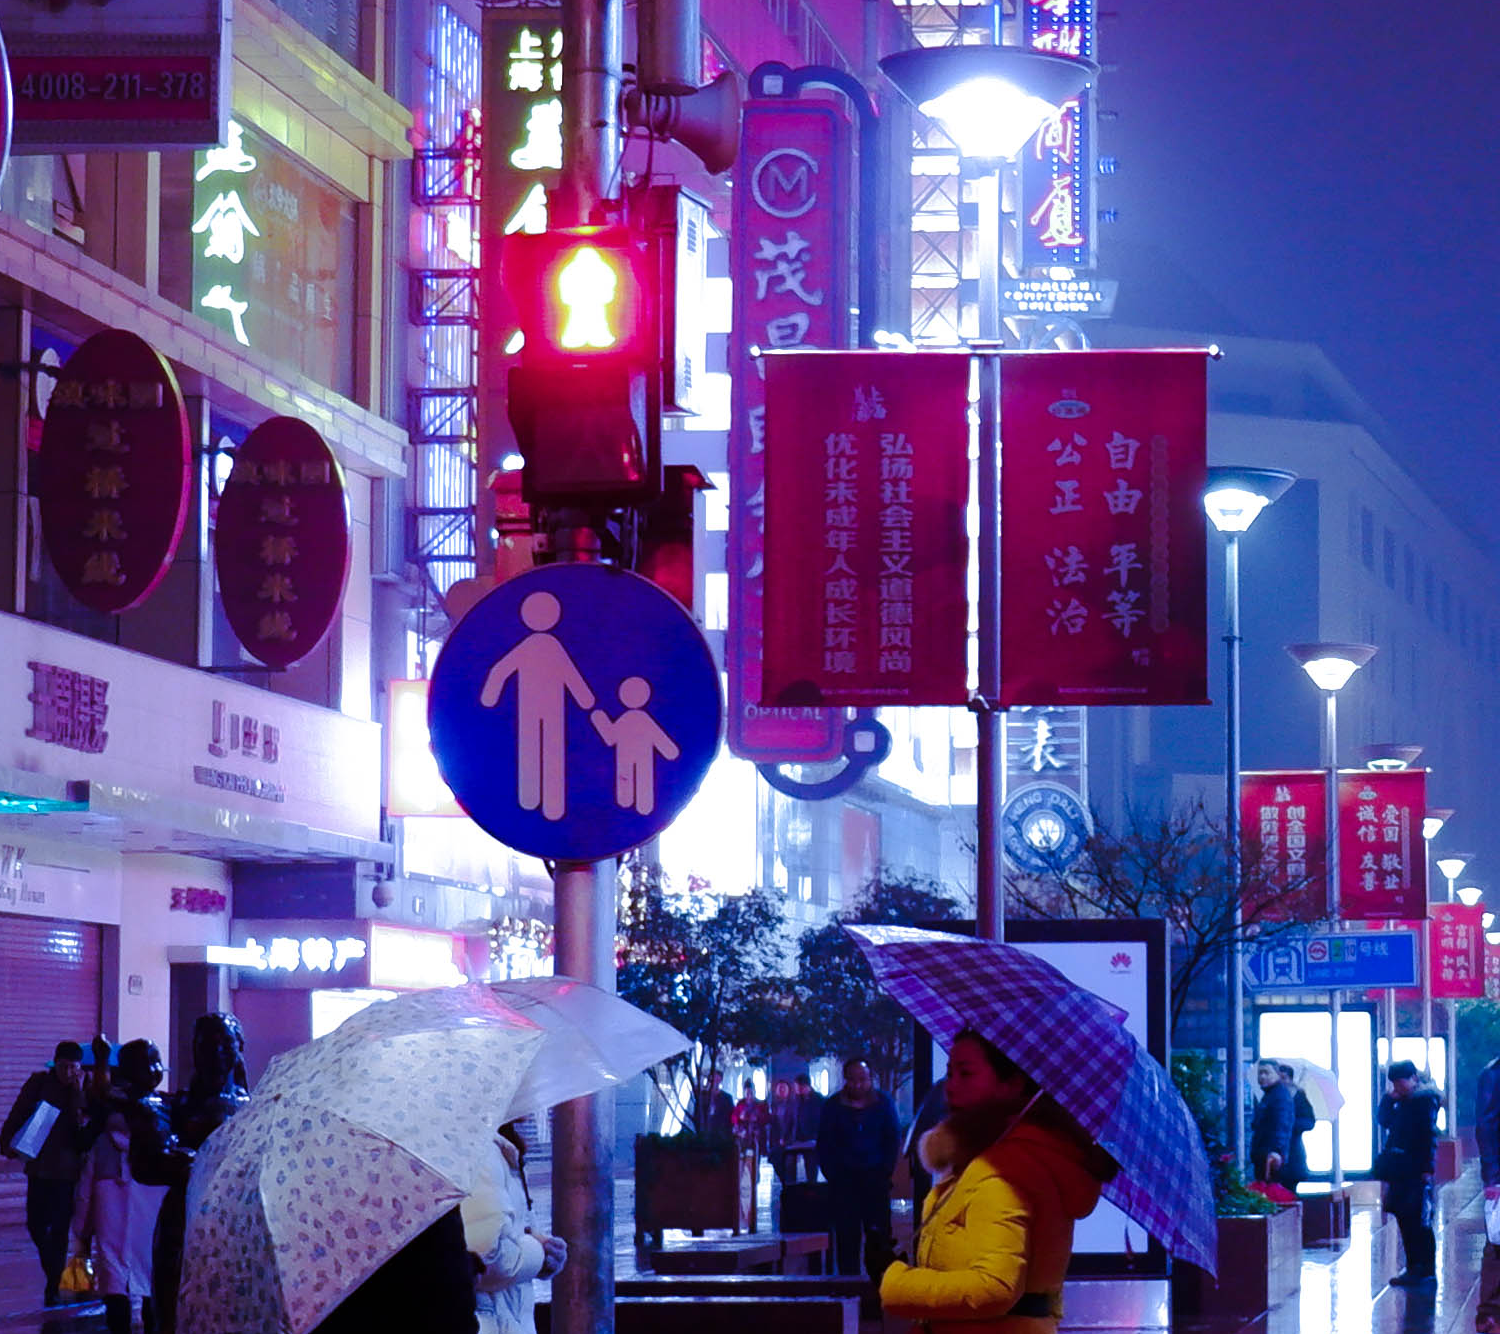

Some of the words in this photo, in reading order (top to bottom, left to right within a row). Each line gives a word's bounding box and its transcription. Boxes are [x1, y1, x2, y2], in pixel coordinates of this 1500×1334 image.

[20, 72, 204, 102] 4008-211-378
[1046, 431, 1089, 516] 公正
[1102, 431, 1143, 516] 自由
[823, 432, 858, 675] 优化未成年人成长环境
[878, 432, 913, 674] 弘扬社会主义道德风尚
[1044, 545, 1090, 637] 法治
[1101, 542, 1144, 639] 平等
